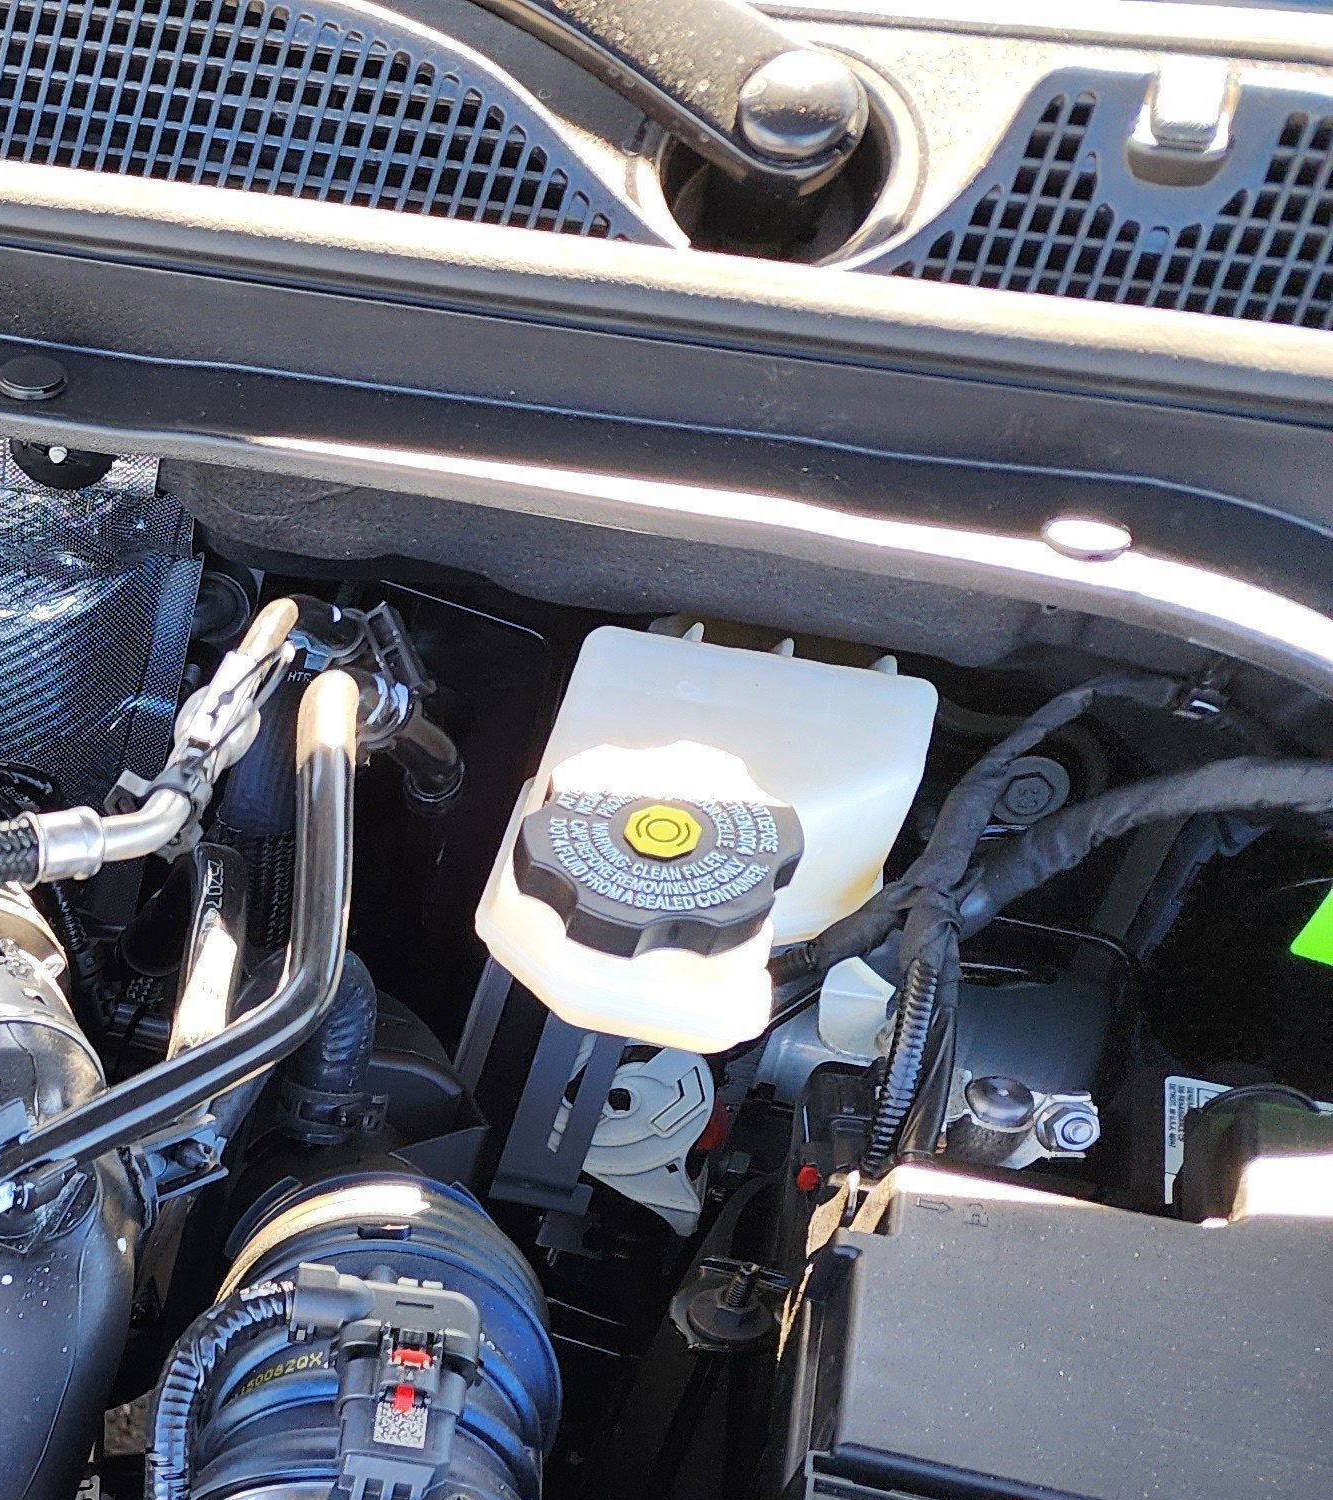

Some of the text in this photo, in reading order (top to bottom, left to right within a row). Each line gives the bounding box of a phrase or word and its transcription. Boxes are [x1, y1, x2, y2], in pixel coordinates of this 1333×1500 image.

[568, 819, 589, 841] CAP
[576, 840, 615, 879] BEFORE
[632, 851, 729, 882] CLEAN FILLER
[717, 857, 747, 884] ONLY
[557, 846, 589, 878] FLUID
[579, 872, 620, 901] FROM
[619, 891, 634, 906] A
[633, 894, 697, 911] SEALED
